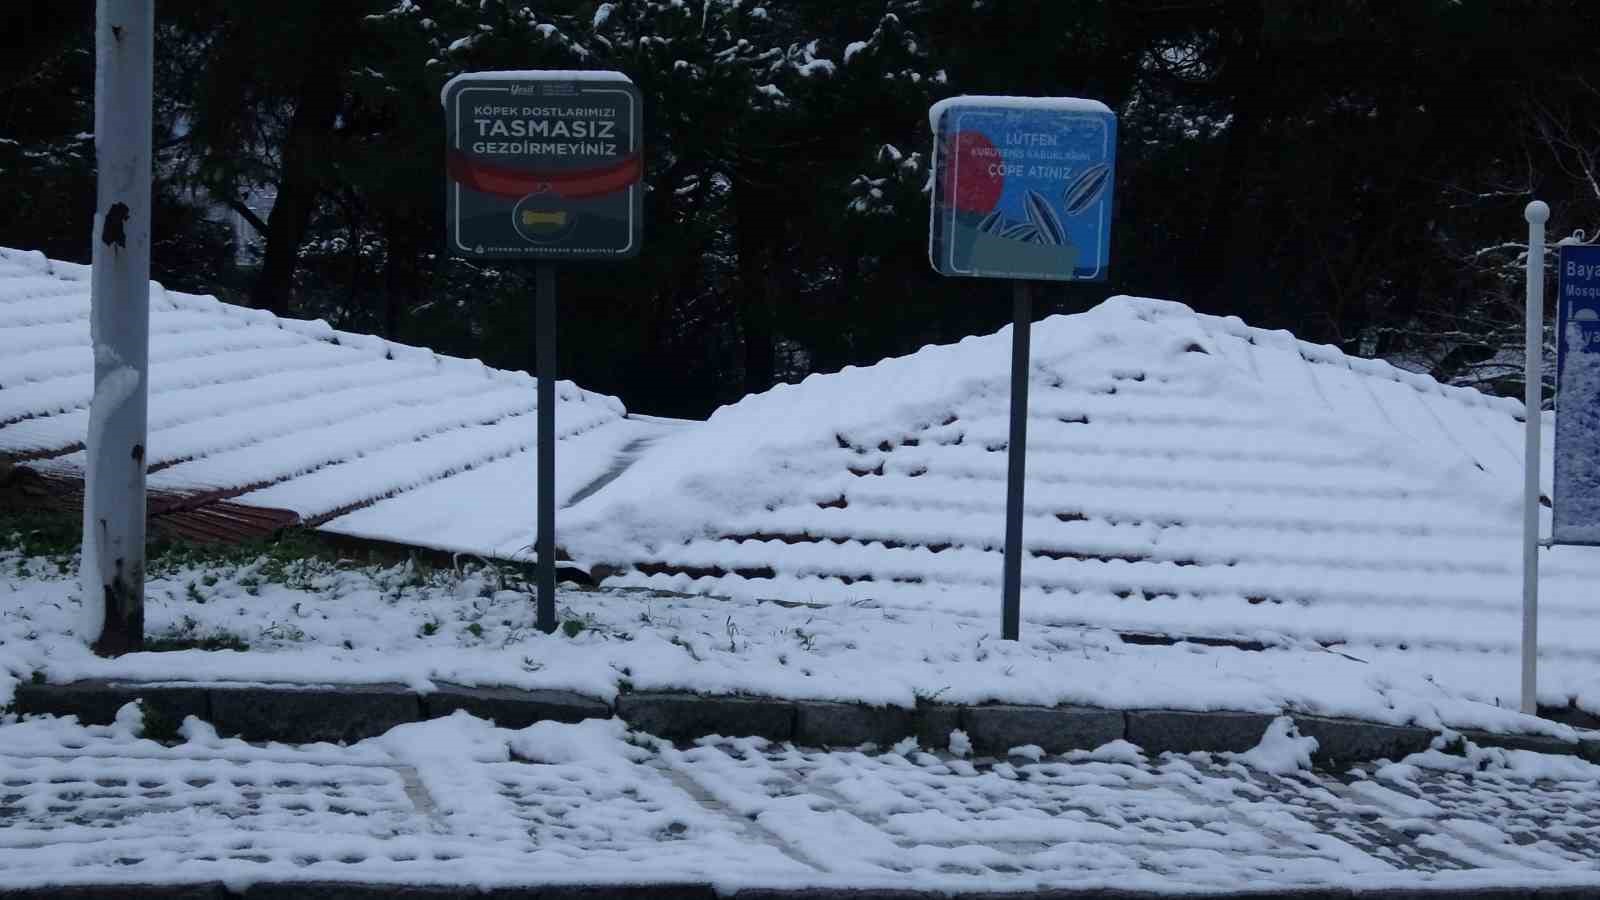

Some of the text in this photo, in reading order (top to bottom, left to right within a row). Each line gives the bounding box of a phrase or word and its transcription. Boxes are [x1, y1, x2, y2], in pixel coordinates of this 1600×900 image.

[473, 105, 616, 118] KÖPEK DOSTLARIMIZI
[473, 119, 616, 138] TASMASIZ
[1006, 130, 1057, 146] LÜTFEN
[472, 140, 617, 156] GEZDİRMEYİNİZ
[988, 161, 1073, 180] ÇÖPE ATINIZ
